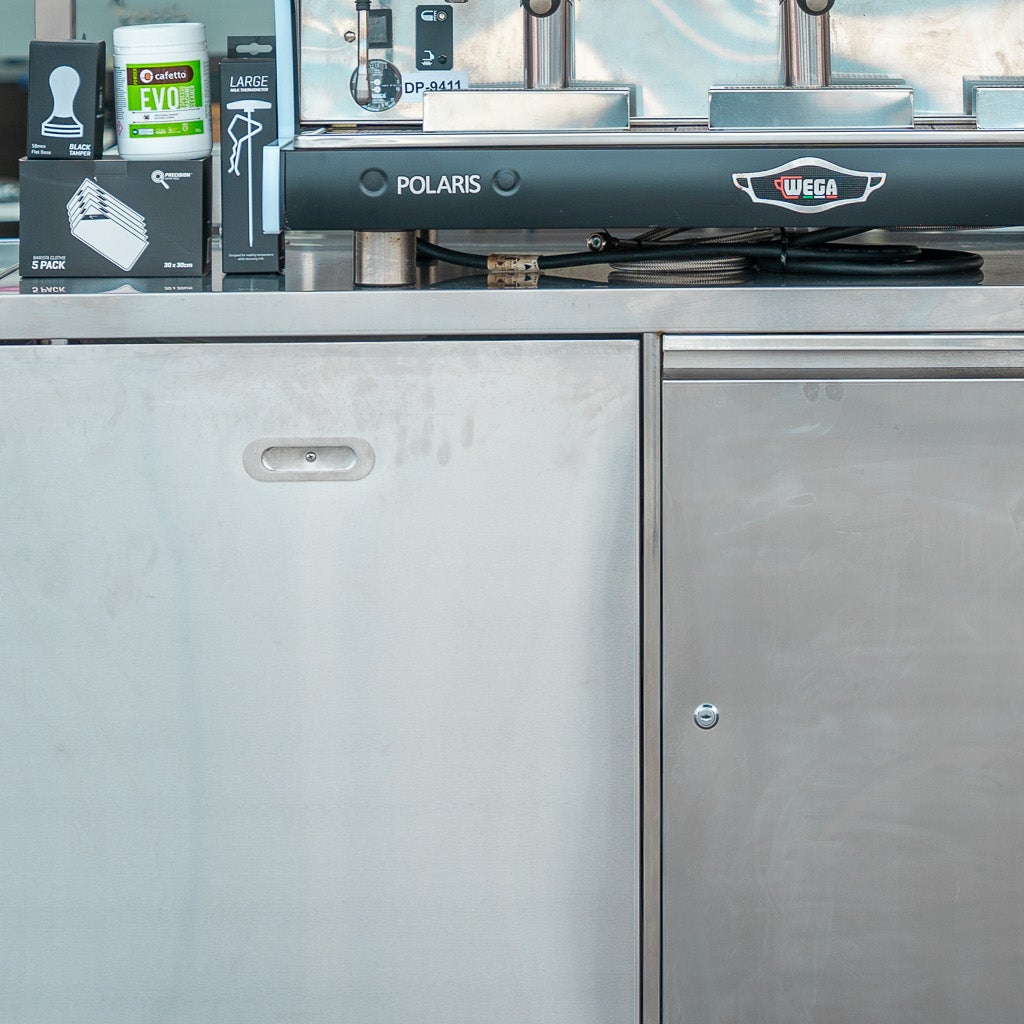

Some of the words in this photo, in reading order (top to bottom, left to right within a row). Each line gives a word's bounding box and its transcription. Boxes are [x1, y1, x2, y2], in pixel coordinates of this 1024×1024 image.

[155, 70, 187, 81] cafetto
[230, 75, 269, 88] LARGE
[404, 80, 461, 94] DP-9411
[140, 86, 179, 112] EVO
[69, 143, 91, 151] BLACK
[397, 174, 482, 195] POLARIS
[783, 178, 838, 196] WEGA
[31, 260, 39, 270] 5
[40, 260, 66, 270] PACK
